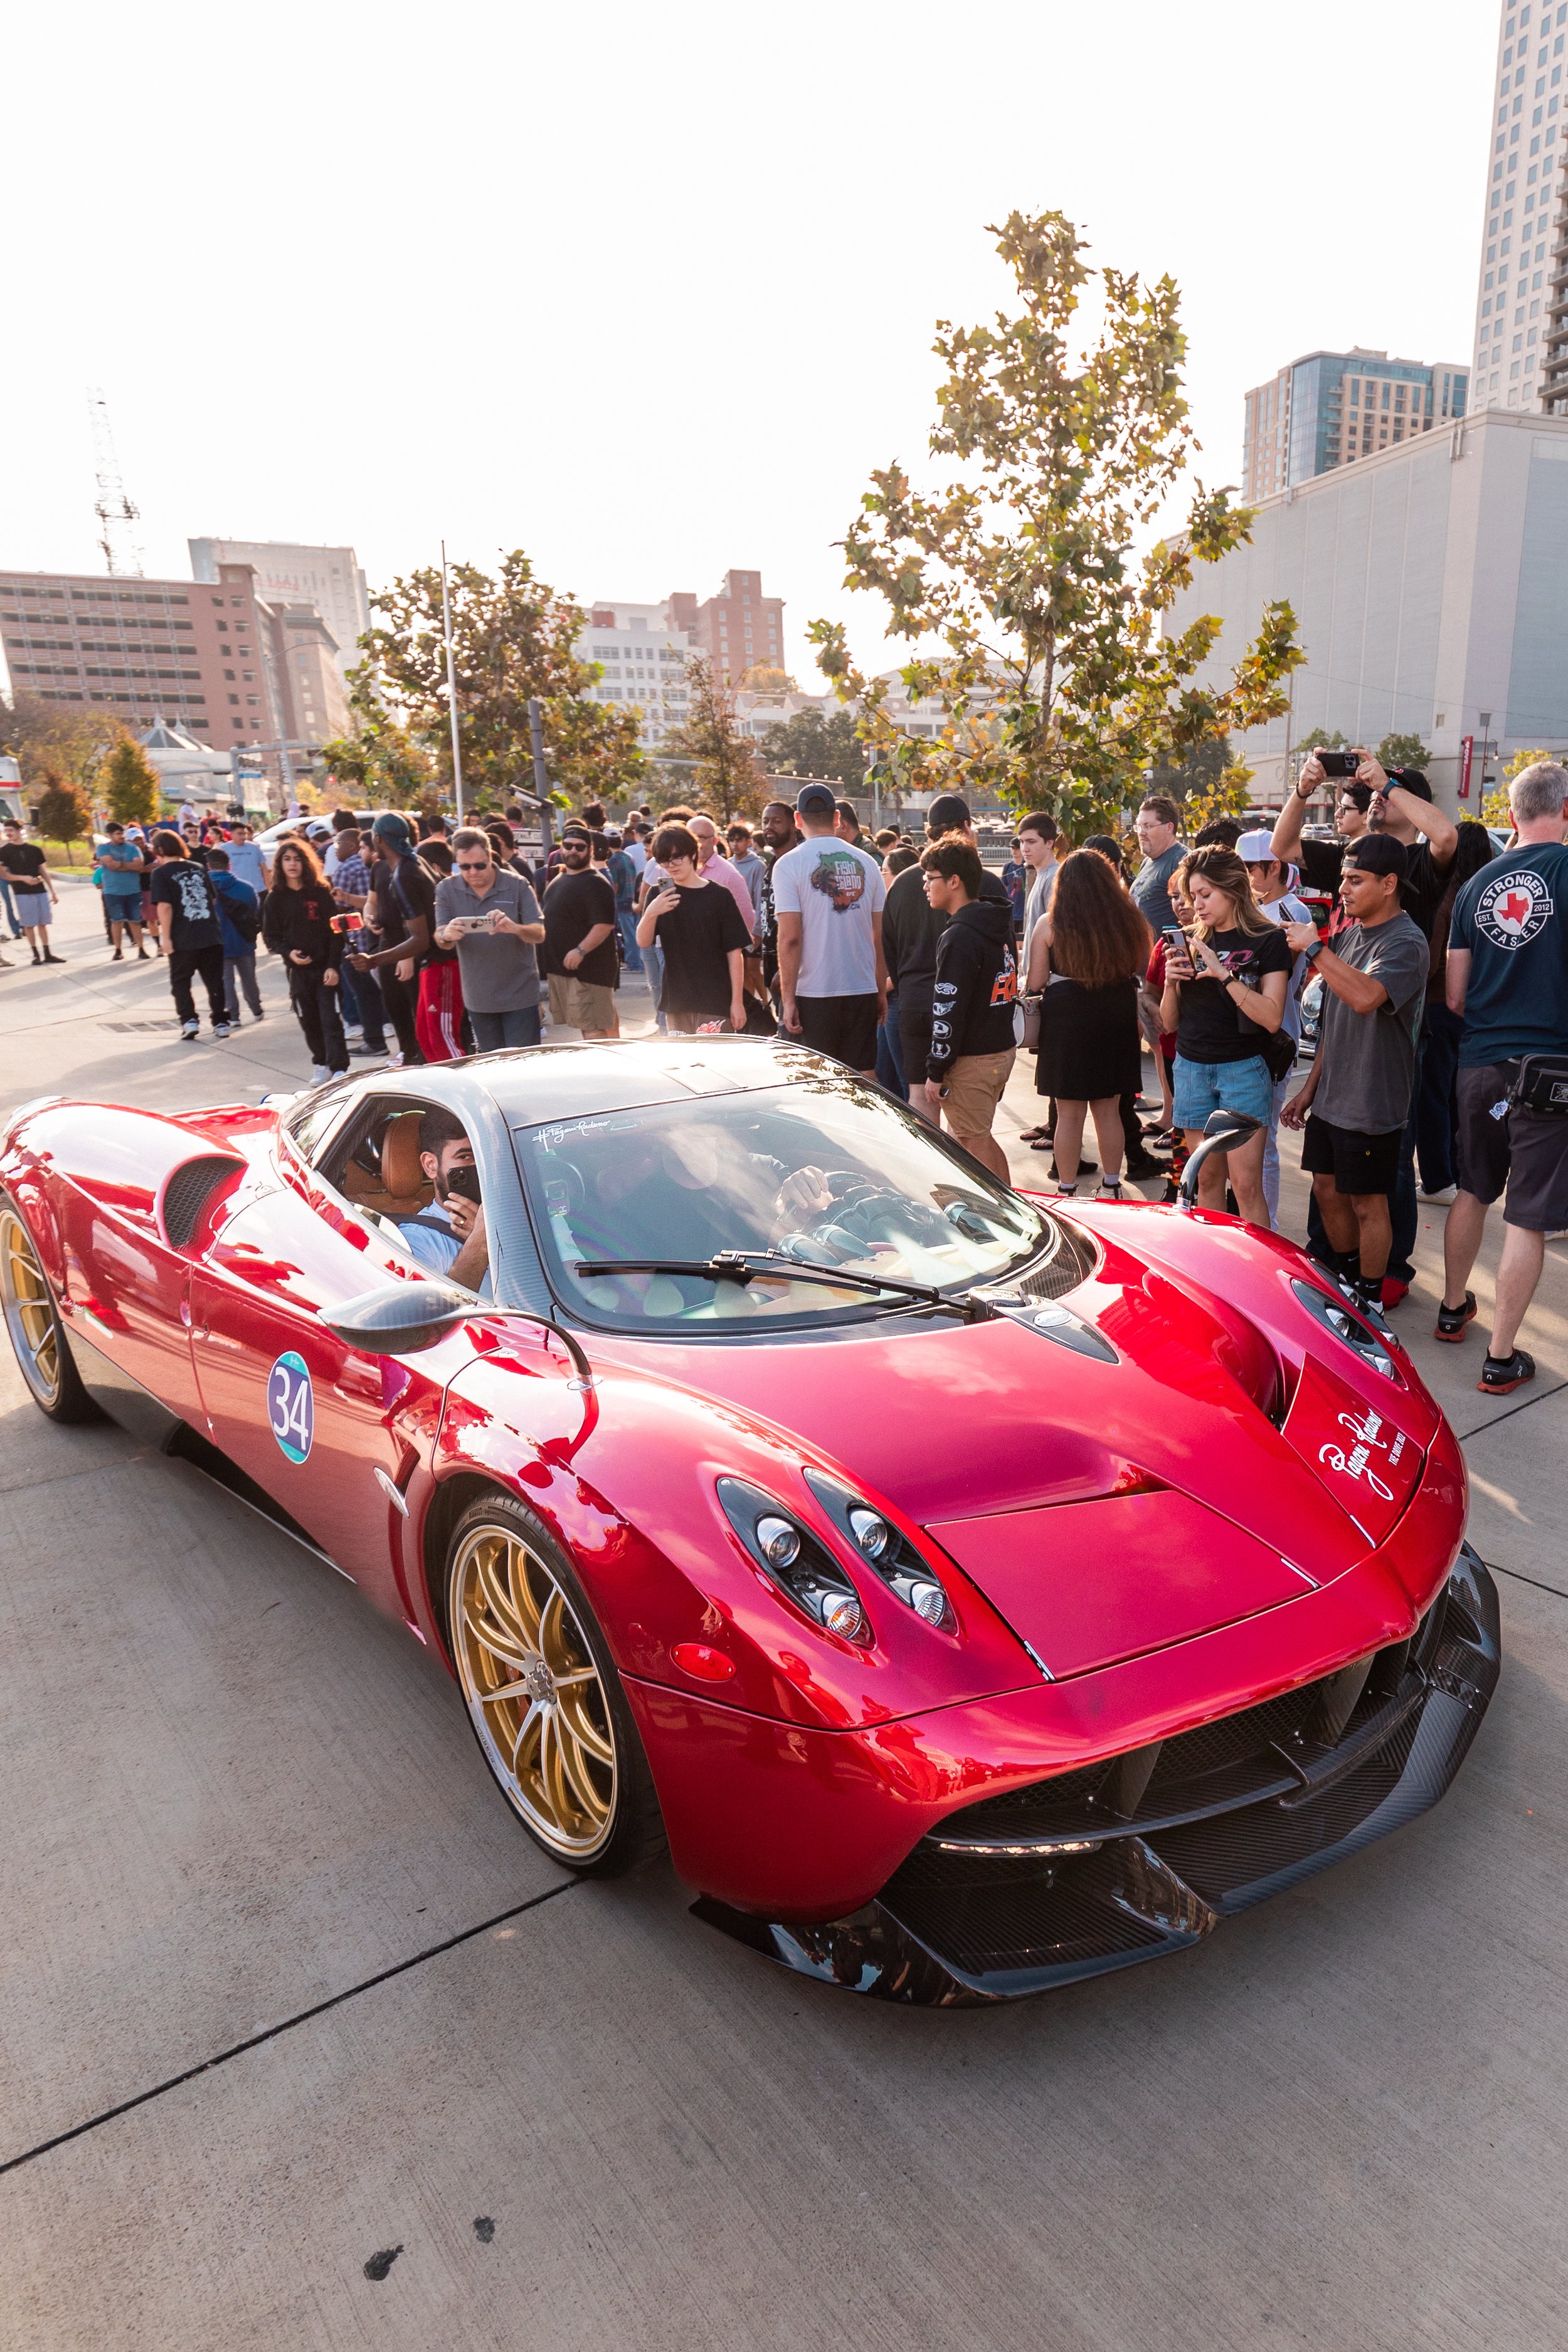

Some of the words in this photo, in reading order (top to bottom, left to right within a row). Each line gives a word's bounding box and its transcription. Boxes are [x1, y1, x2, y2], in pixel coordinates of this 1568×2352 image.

[1482, 874, 1544, 908] STRONGER
[1478, 914, 1491, 923] EST.
[1534, 903, 1550, 912] 2012
[1491, 919, 1540, 946] FASER
[273, 1366, 309, 1451] 34
[1337, 1407, 1388, 1449] Raduno
[1396, 1432, 1406, 1446] 2022
[1388, 1453, 1399, 1466] THE
[1391, 1441, 1404, 1458] DRIVE
[1318, 1439, 1394, 1501] Pagani
